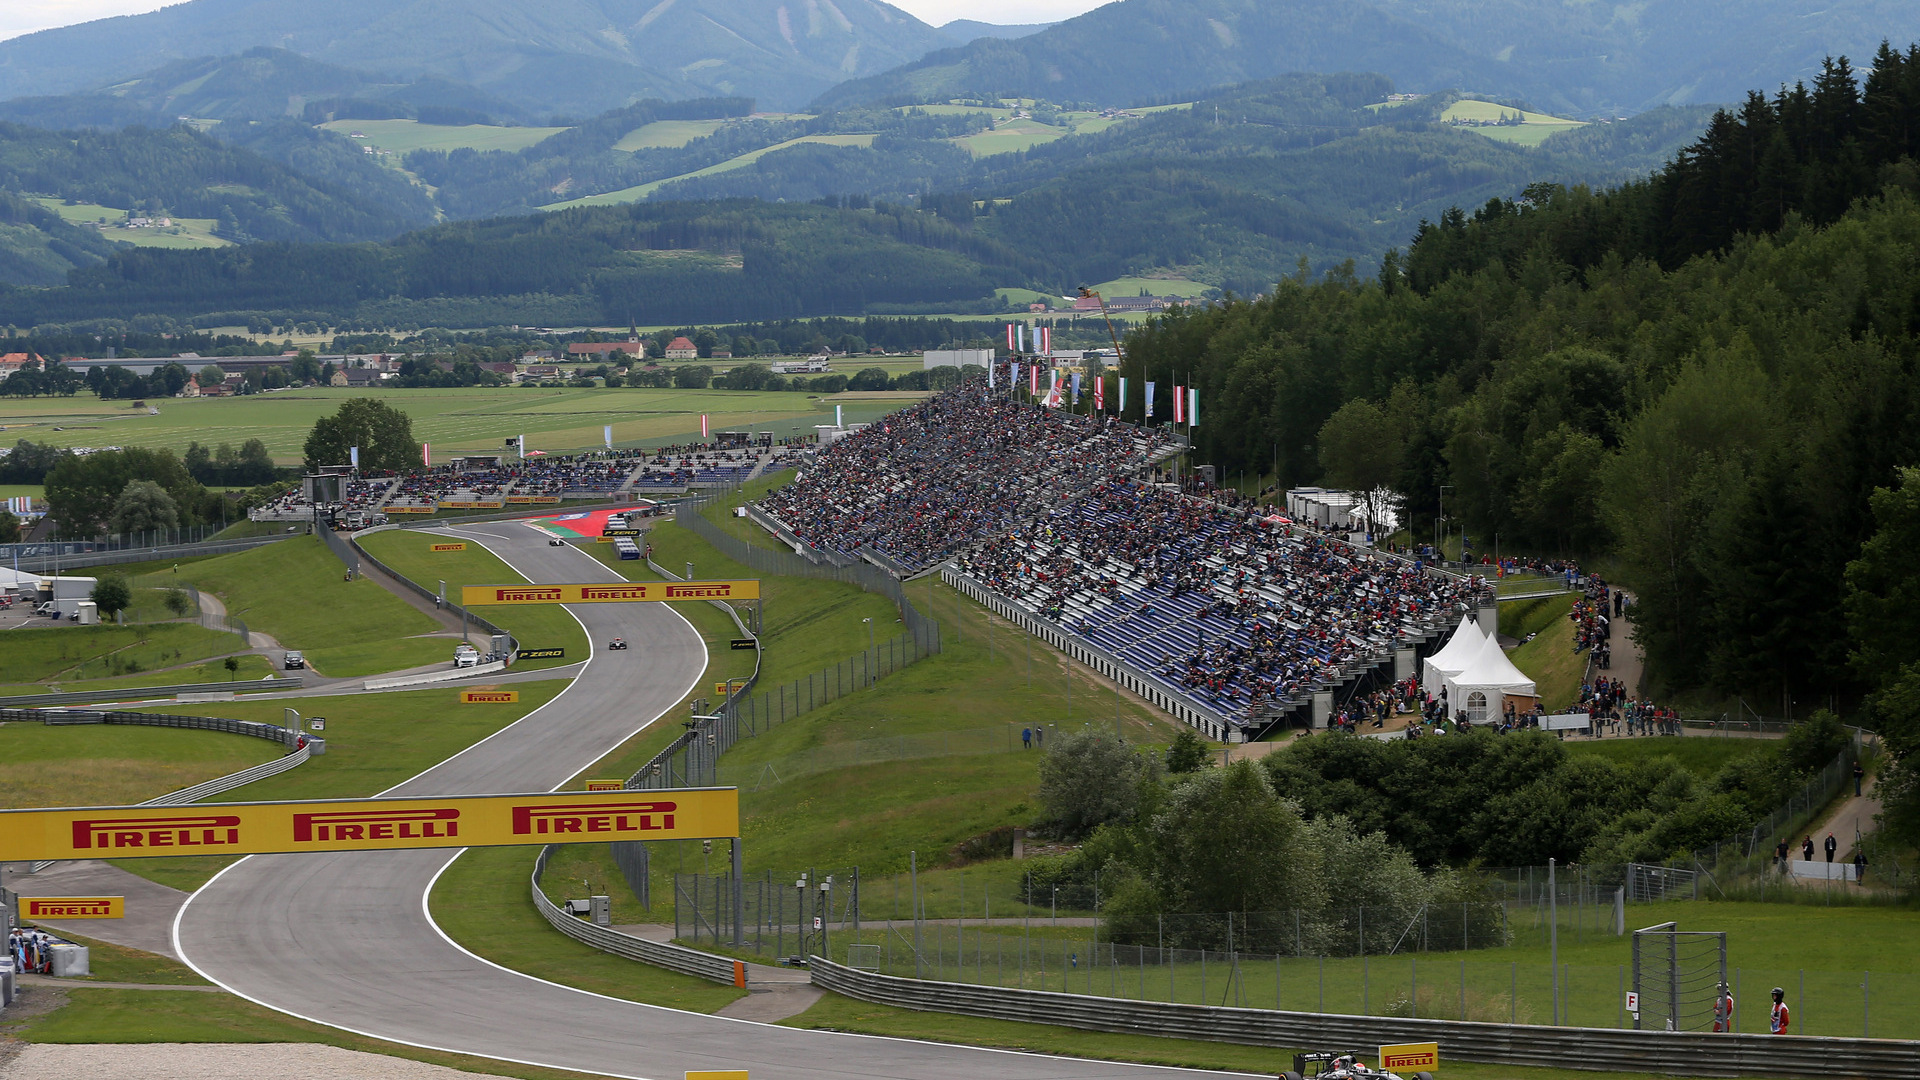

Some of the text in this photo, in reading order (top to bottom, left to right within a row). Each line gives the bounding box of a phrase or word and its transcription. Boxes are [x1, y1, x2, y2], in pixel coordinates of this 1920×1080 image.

[496, 585, 731, 601] PIRELLI PIRELLI PIRELLI
[467, 693, 511, 702] PIRELLI
[72, 802, 677, 849] PIRELLI PIRELLI PIRELLI
[30, 901, 111, 915] PIRELLI
[1628, 995, 1635, 1007] F
[1384, 1052, 1433, 1068] PIRELLI
